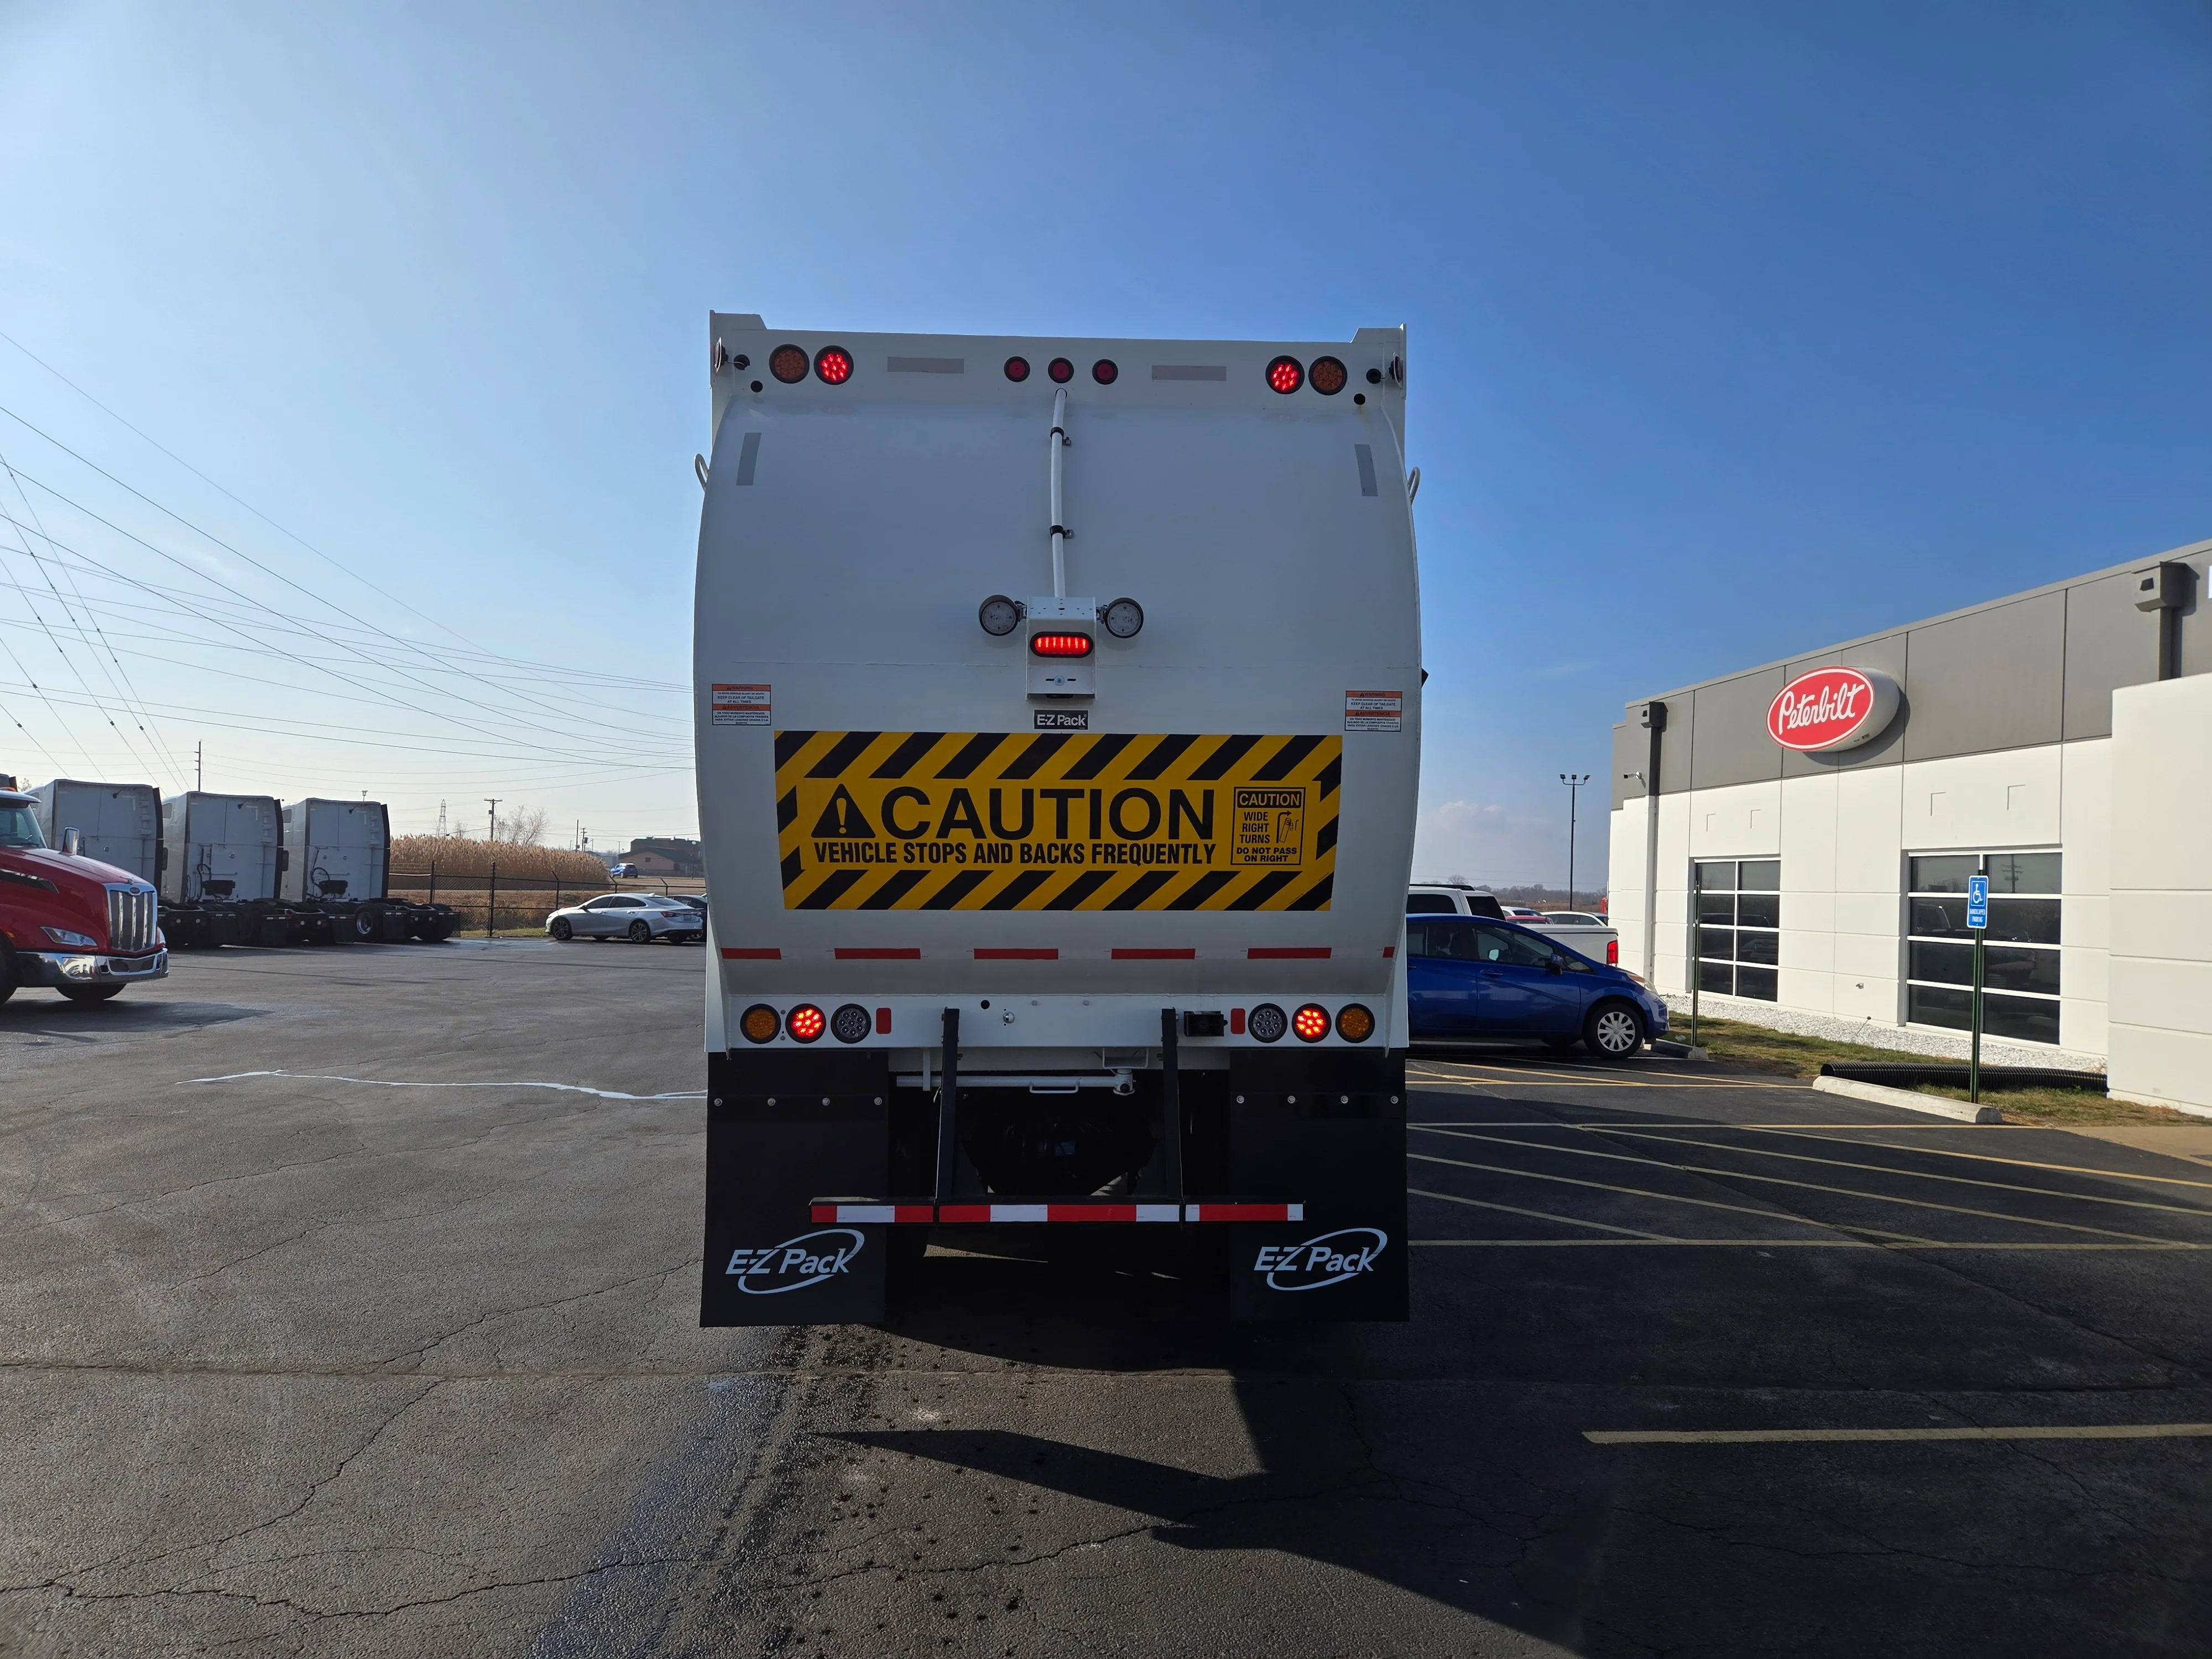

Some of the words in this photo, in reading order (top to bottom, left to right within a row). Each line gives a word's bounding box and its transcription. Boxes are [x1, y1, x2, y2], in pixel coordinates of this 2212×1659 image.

[1778, 682, 1865, 735] Peterbilt
[1037, 714, 1055, 725] E-Z
[1057, 714, 1086, 726] Pack
[1239, 793, 1300, 806] CAUTION
[881, 786, 1214, 841] CAUTION
[1244, 812, 1268, 821] WIDE
[1242, 823, 1269, 832] RIGHT
[1239, 834, 1270, 843] TURNS
[814, 842, 898, 863] VEHICLE
[903, 842, 967, 864] STOPS
[973, 843, 1013, 864] AND
[1020, 843, 1085, 864] BACKS
[1092, 843, 1217, 867] FREQUENTLY
[725, 1249, 780, 1274] E-Z
[779, 1248, 849, 1274] Pack
[1254, 1246, 1306, 1271] E-Z
[1305, 1247, 1374, 1271] Pack
